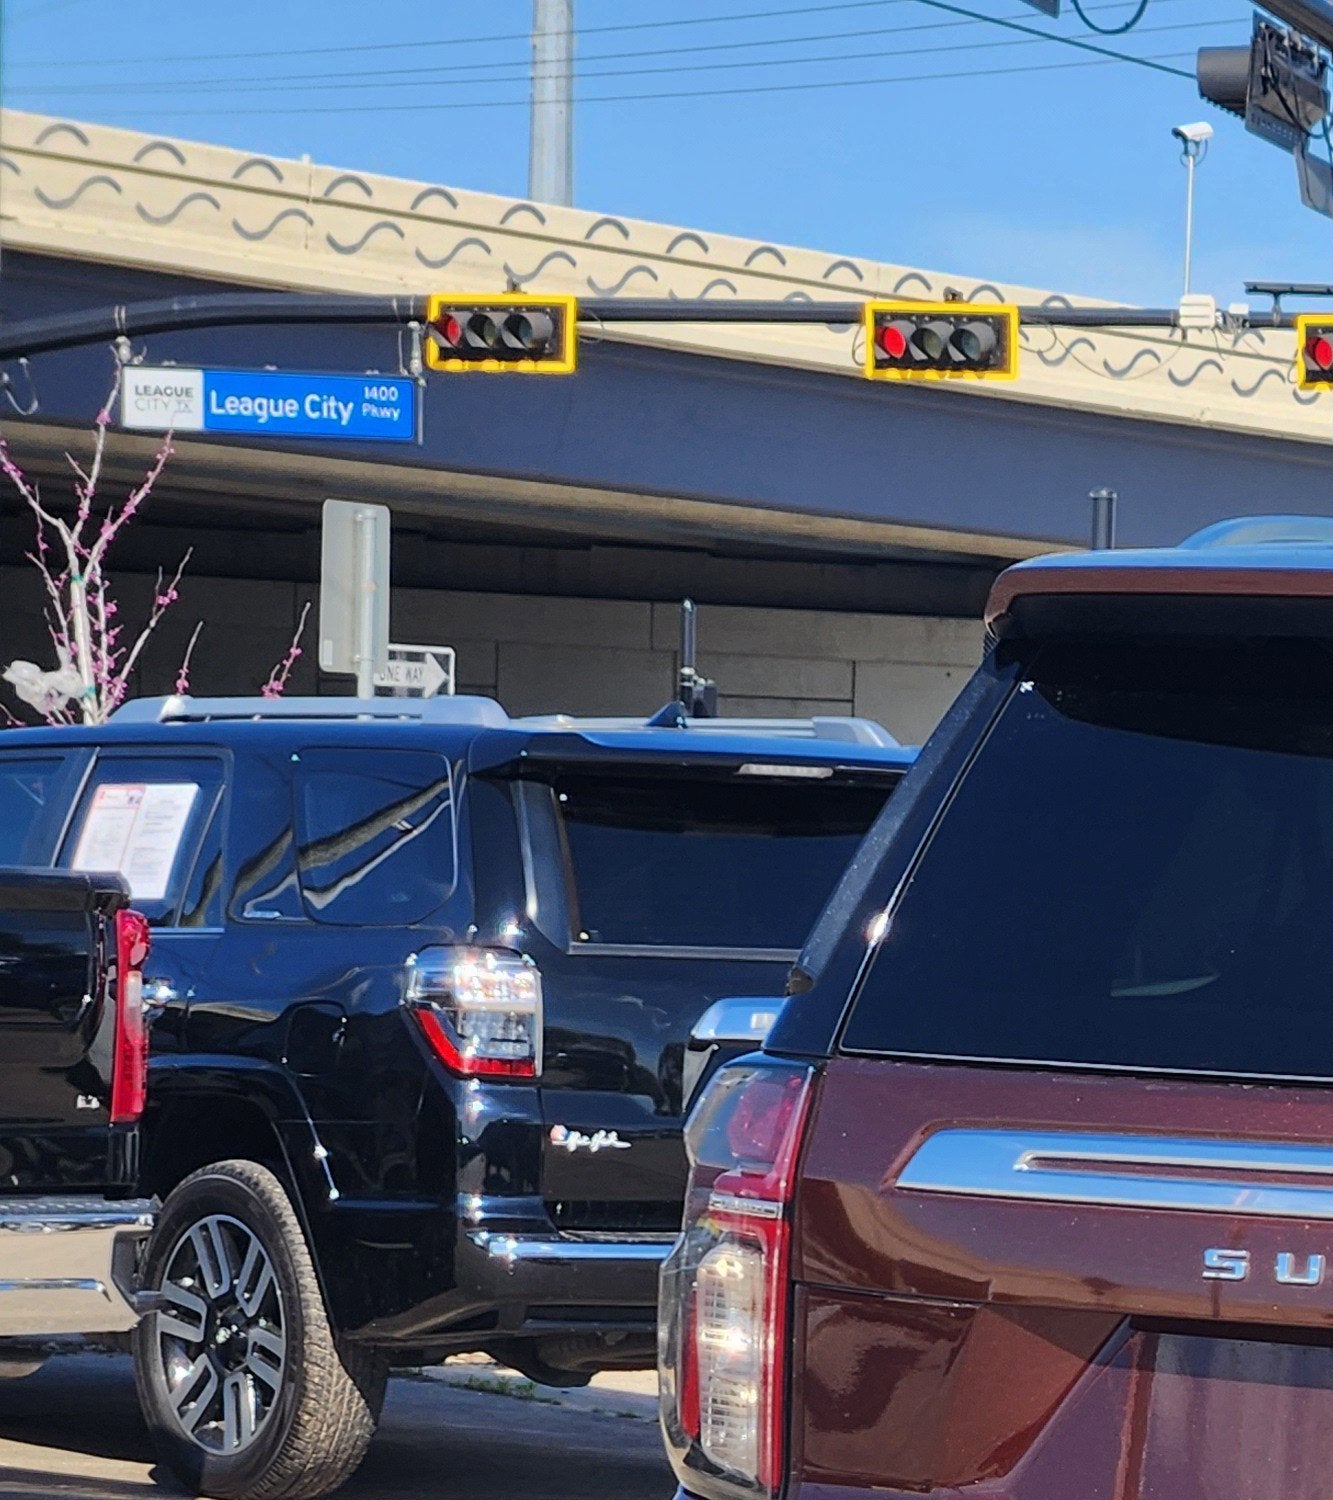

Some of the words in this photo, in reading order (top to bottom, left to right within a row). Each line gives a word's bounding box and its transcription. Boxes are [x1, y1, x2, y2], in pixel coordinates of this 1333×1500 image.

[135, 385, 193, 398] LEAGUE
[363, 386, 399, 401] 1400
[135, 399, 169, 412] CITY
[210, 389, 299, 424] League
[304, 393, 354, 426] City
[362, 403, 401, 422] Pkwy
